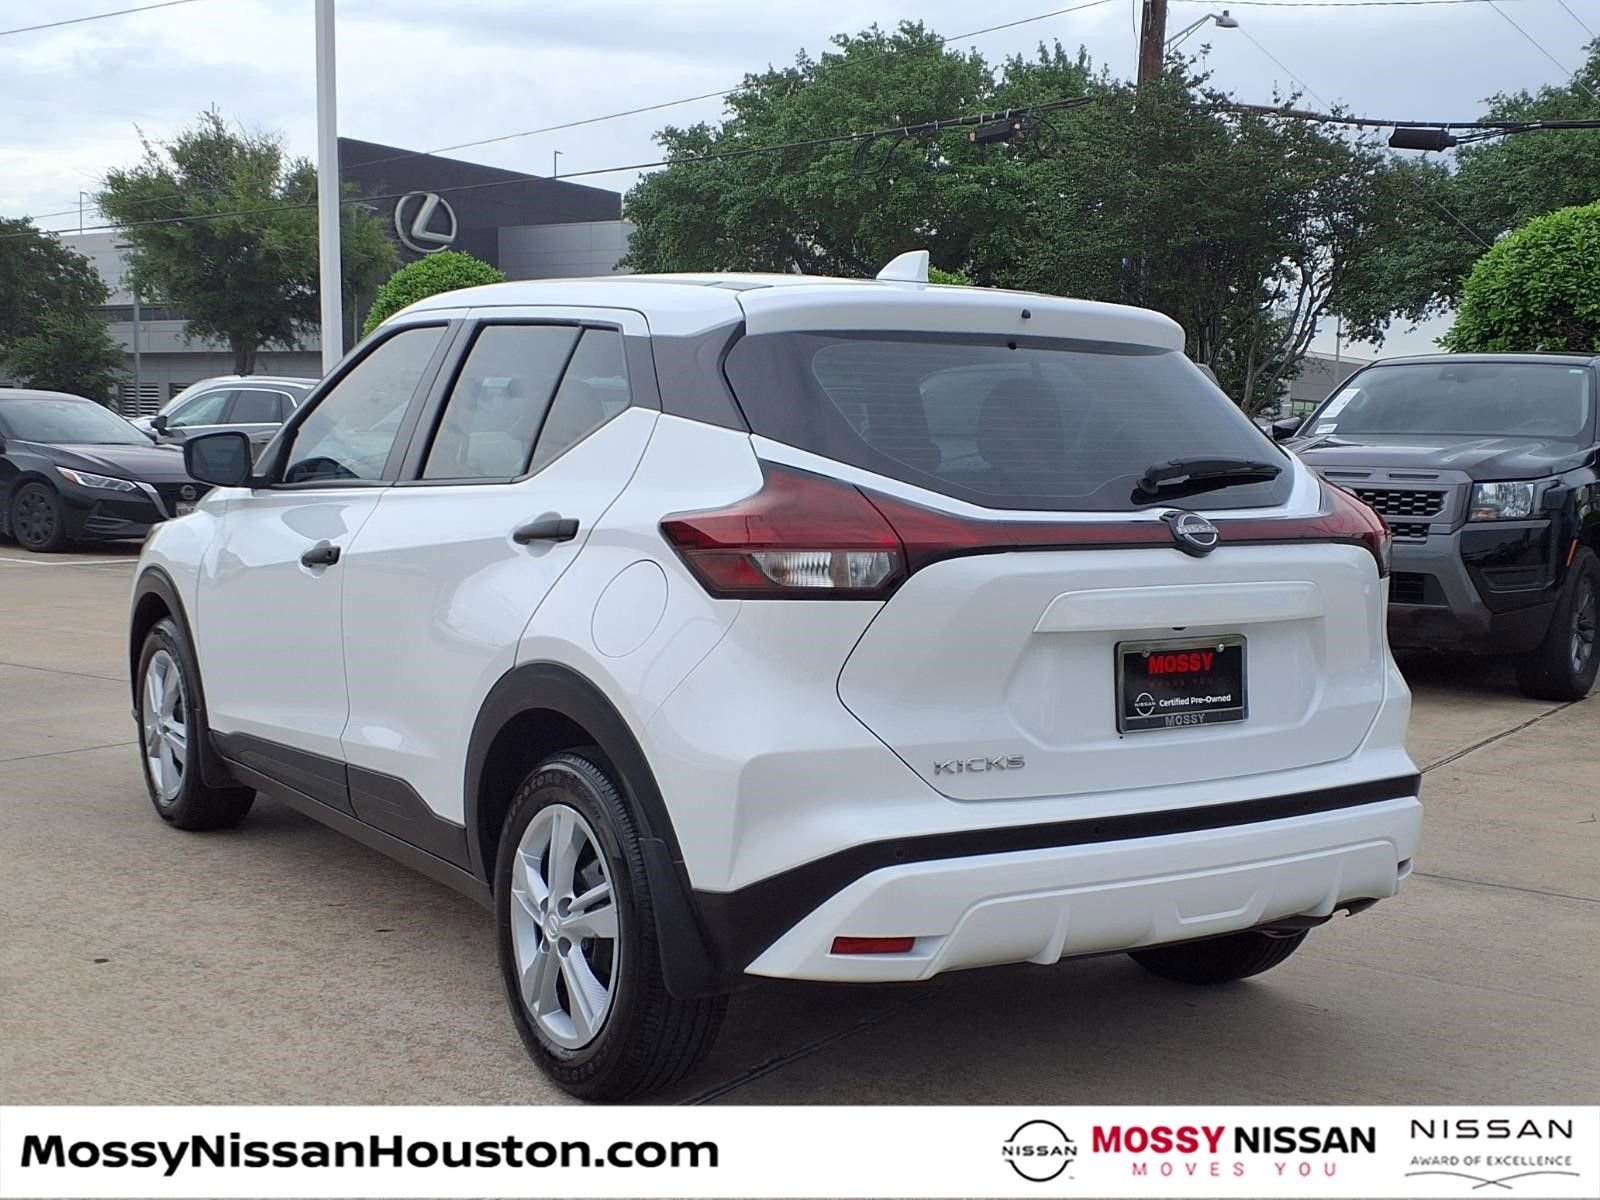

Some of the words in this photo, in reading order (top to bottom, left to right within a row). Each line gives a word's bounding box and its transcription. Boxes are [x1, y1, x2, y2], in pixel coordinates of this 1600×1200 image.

[1148, 652, 1214, 673] MOSSY
[1159, 696, 1189, 707] Certified
[1191, 694, 1231, 705] Pre-Owned
[1165, 713, 1206, 727] MOSSY
[934, 755, 1025, 775] KICKS
